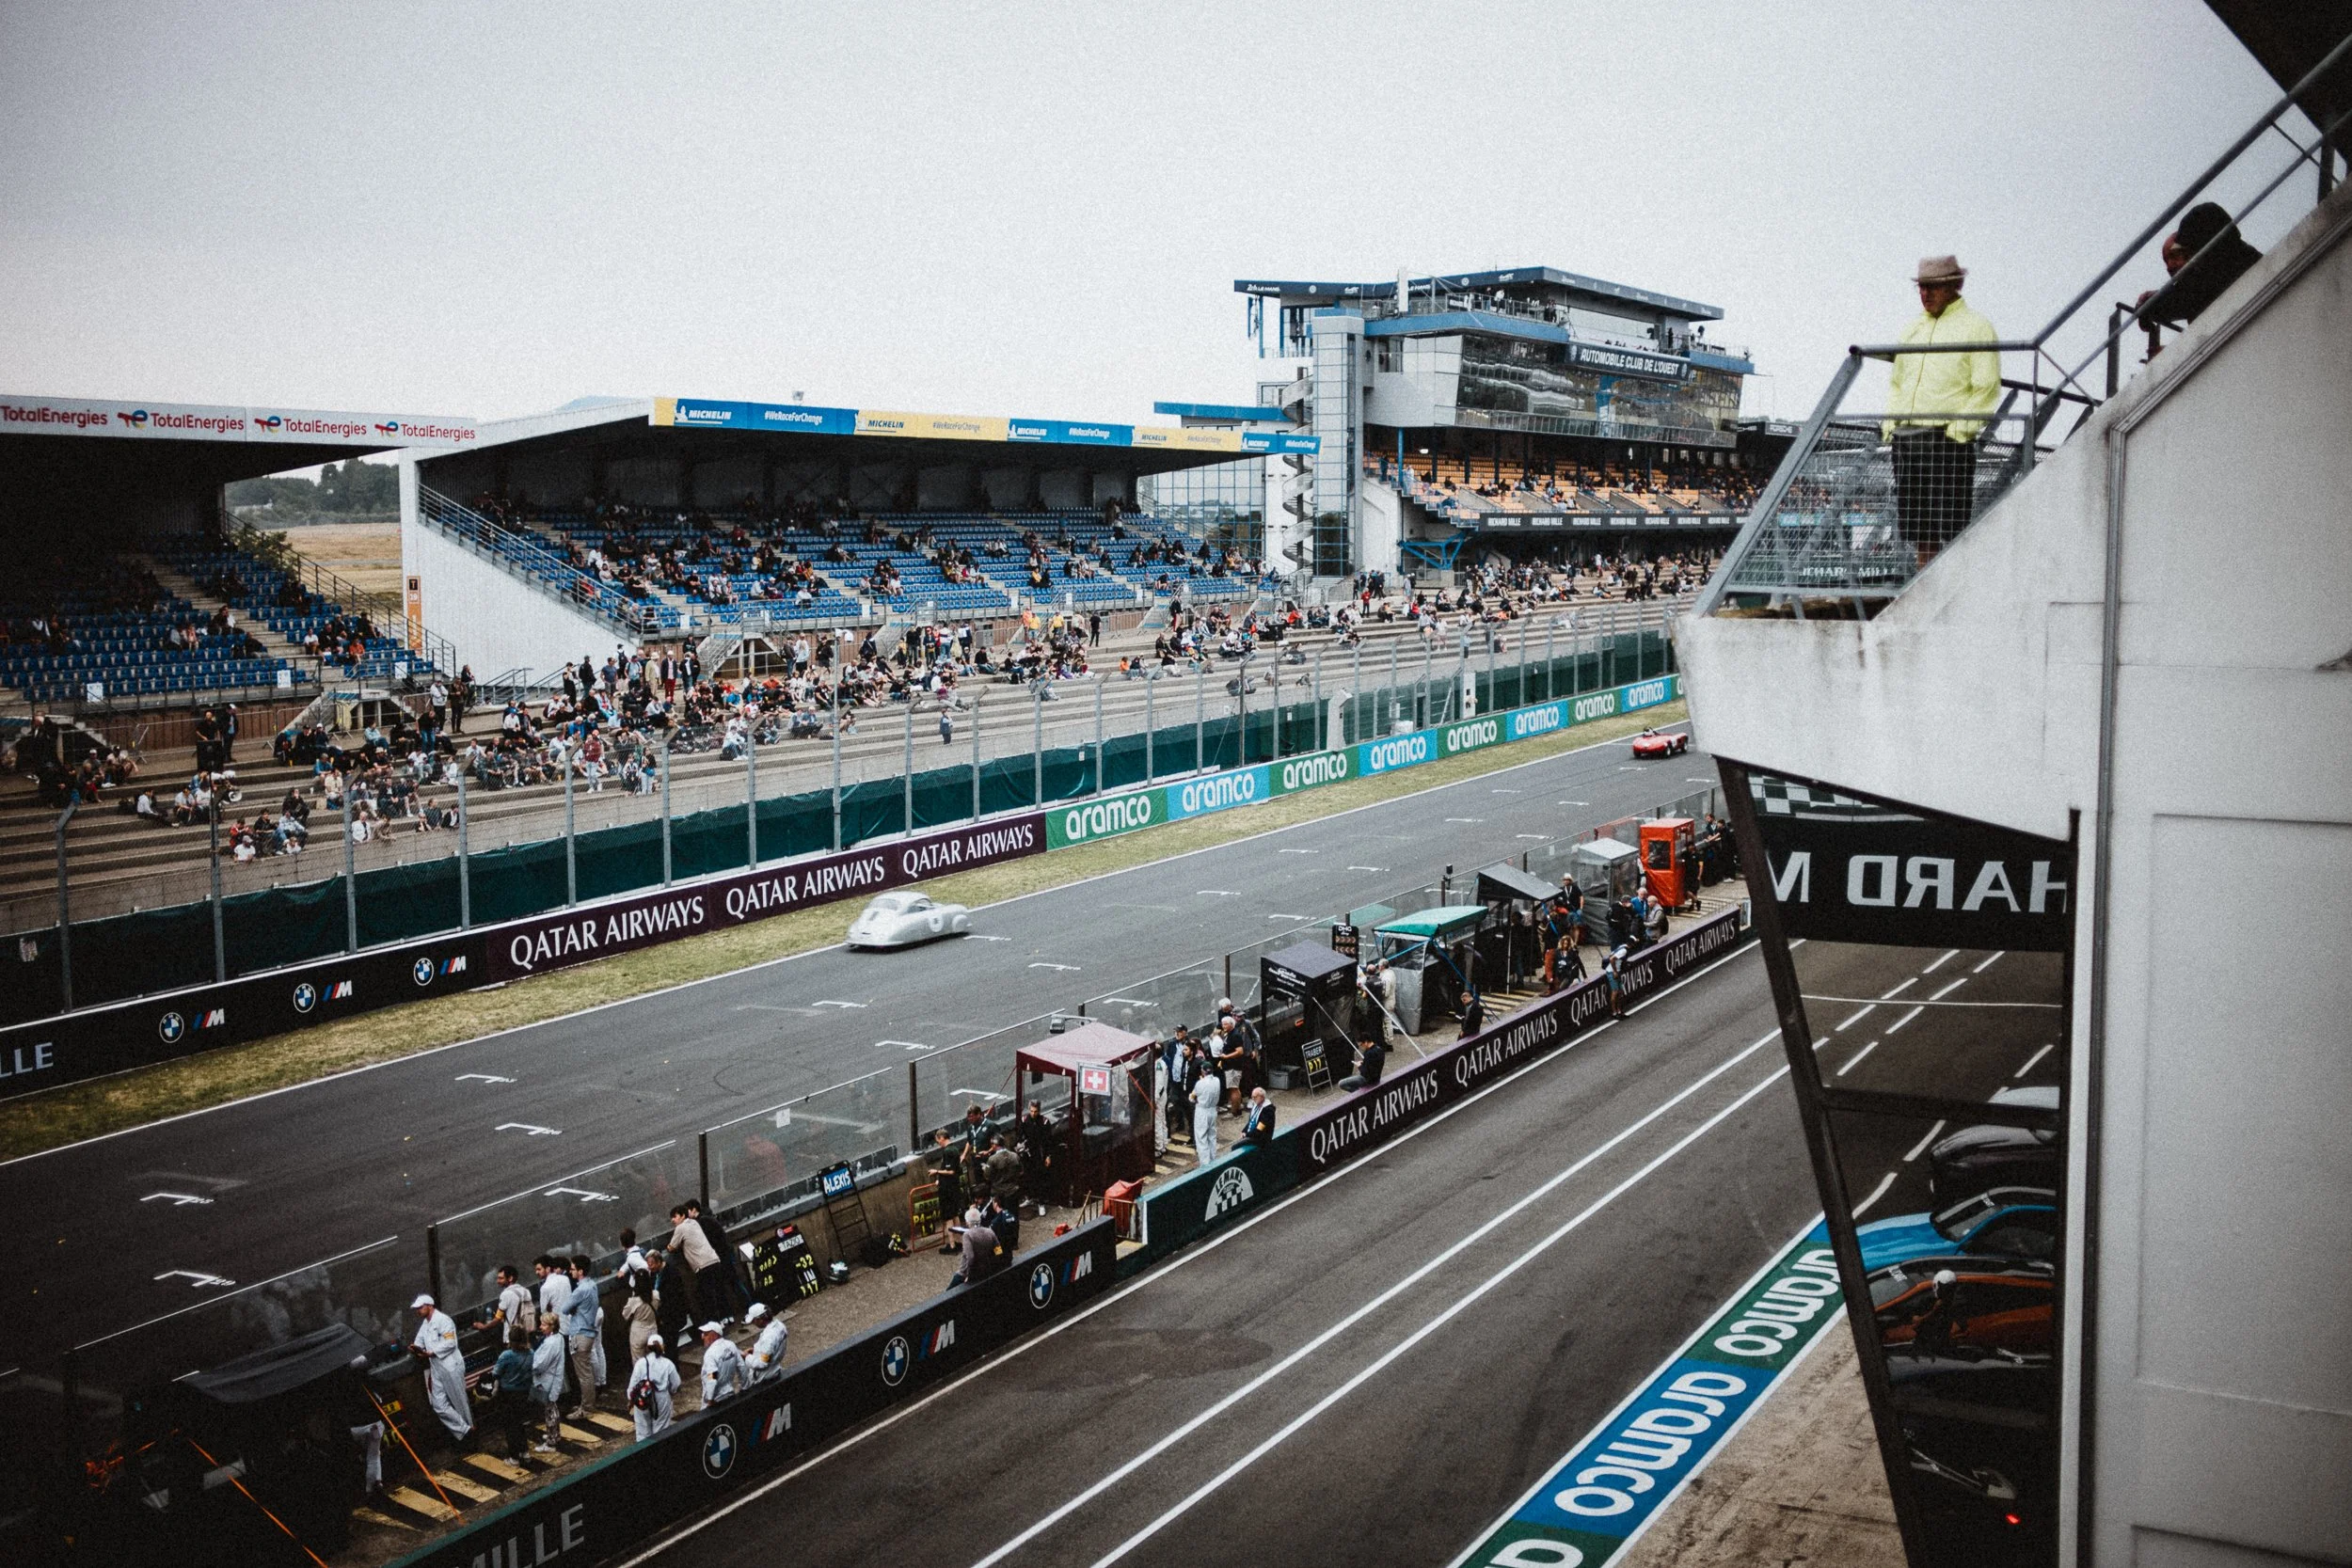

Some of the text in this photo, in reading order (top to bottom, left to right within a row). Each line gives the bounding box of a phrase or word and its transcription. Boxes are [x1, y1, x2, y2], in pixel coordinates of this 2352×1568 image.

[1581, 349, 1679, 375] AUTOMOBILE CLUB DE L'OUEST
[1, 405, 107, 428] TotalEnergies
[150, 412, 245, 433] TotalEnergies
[283, 419, 367, 437] TotalEnergies
[688, 409, 823, 425] MICHELIN #WeRaceForChange
[867, 420, 905, 429] MICHELIN
[1016, 427, 1047, 436] MICHELIN
[401, 423, 475, 441] TotalEnergies
[1575, 693, 1614, 721] aramco
[1629, 681, 1665, 707] aramco
[1515, 705, 1559, 735] aramco
[1447, 721, 1497, 752] aramco
[1371, 736, 1426, 770] aramco
[1283, 752, 1347, 789] aramco
[1182, 772, 1255, 813] aramco
[1065, 795, 1152, 840] aramco
[902, 824, 1034, 879] QATAR AIRWAYS
[725, 856, 885, 920] QATAR AIRWAYS
[510, 895, 705, 971] QATAR AIRWAYS
[1665, 918, 1736, 976] QATAR AIRWAYS
[1571, 960, 1654, 1026] QATAR RWAYS
[1455, 1009, 1558, 1087] QATAR AIRWAYS
[1308, 1057, 1322, 1073] P17
[1311, 1069, 1438, 1164] QATAR AIRWAYS
[823, 1169, 851, 1195] ALEXIS
[795, 1254, 814, 1269] -32
[1714, 1249, 1841, 1356] aramco
[1554, 1370, 1747, 1516] aramco
